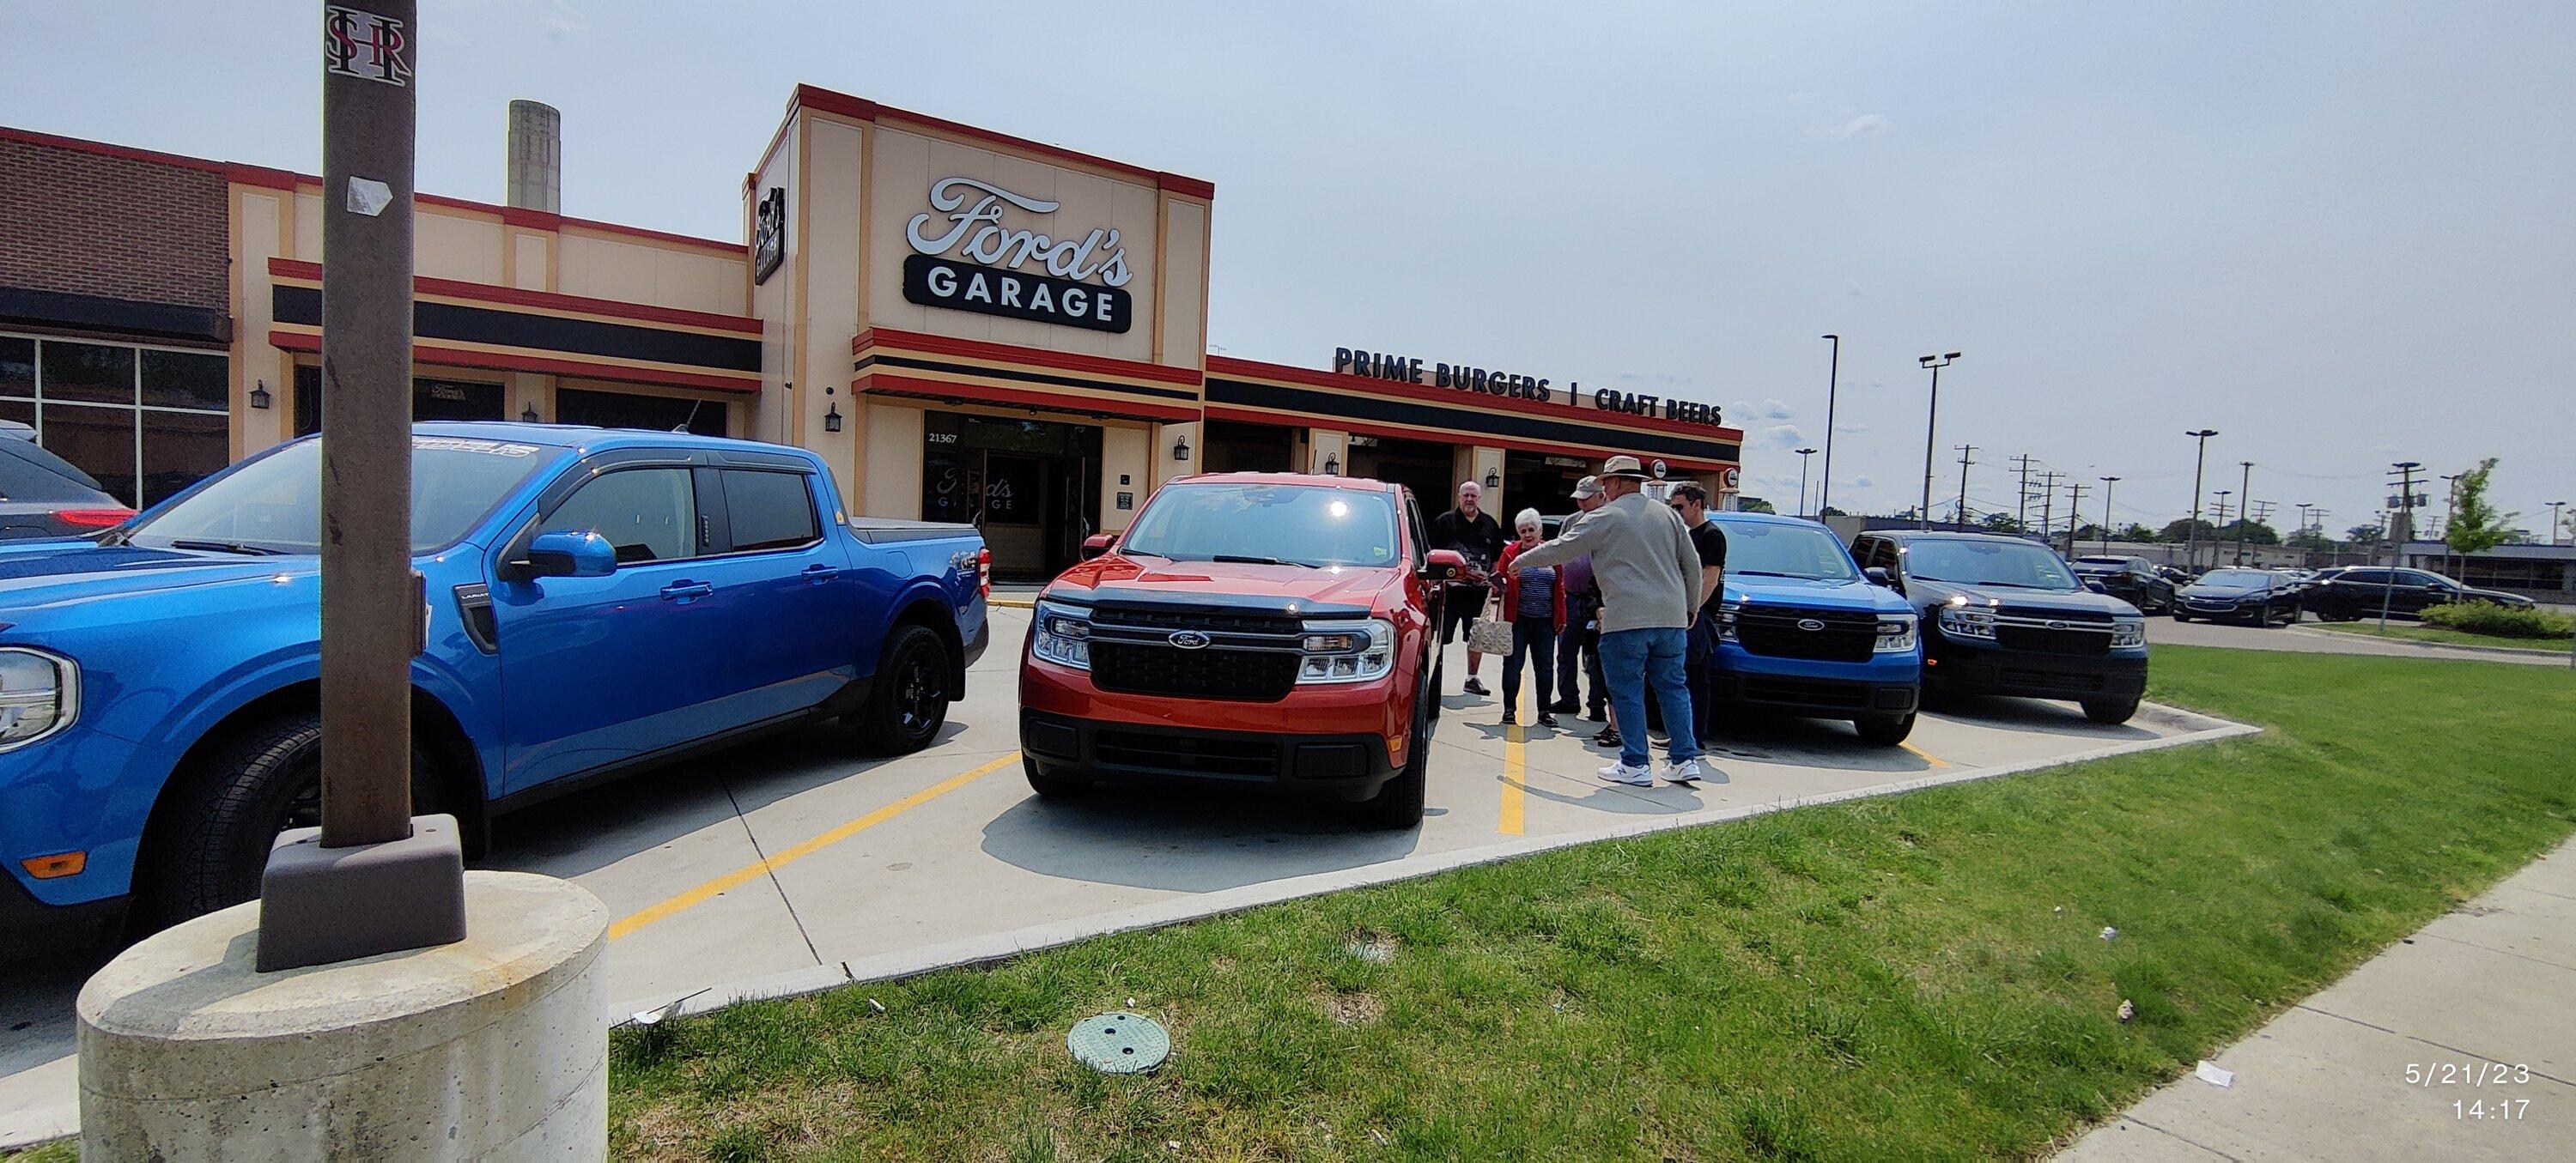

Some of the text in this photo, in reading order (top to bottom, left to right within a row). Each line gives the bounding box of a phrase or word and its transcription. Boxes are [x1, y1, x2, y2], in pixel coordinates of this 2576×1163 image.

[907, 177, 1133, 287] Ford's
[927, 266, 1113, 322] GARAGE
[1335, 347, 1423, 384] PRIME
[1435, 362, 1551, 403] BURGERS
[1595, 388, 1659, 417] CRAFT
[1666, 399, 1722, 427] BEERS
[928, 432, 958, 445] 21367
[1177, 634, 1200, 645] Ford
